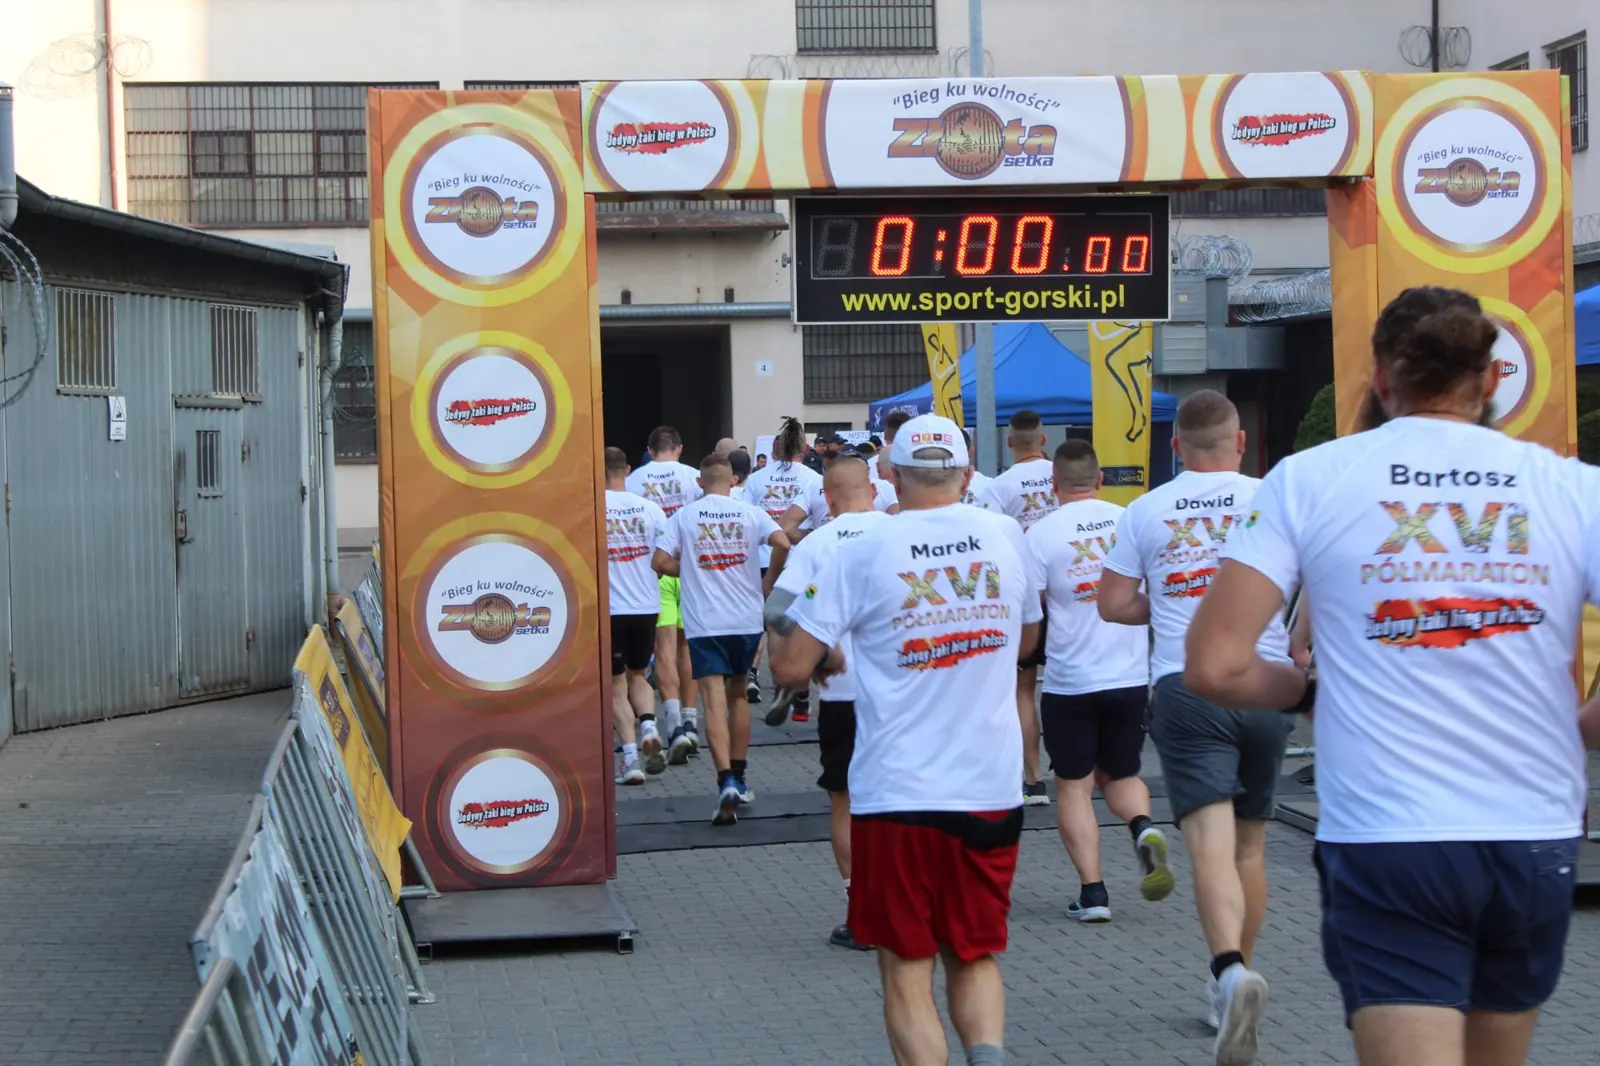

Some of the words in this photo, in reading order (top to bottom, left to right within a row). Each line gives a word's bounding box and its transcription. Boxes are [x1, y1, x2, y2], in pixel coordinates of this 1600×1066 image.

[946, 81, 966, 97] ku
[606, 130, 637, 147] Jedyny
[639, 130, 656, 144] taki
[657, 128, 676, 143] bieg
[677, 129, 686, 140] w
[686, 126, 716, 139] Polsce
[1231, 123, 1261, 140] Jedyny
[1262, 124, 1279, 136] taki
[1280, 121, 1297, 134] bieg
[1298, 121, 1307, 131] w
[1307, 117, 1336, 129] Polsce
[1451, 144, 1464, 155] ku
[1003, 155, 1054, 167] setka
[463, 172, 477, 183] ku
[1487, 190, 1519, 199] setka
[503, 220, 537, 229] setka
[841, 283, 1126, 316] www.sport-gorski.pl
[1501, 363, 1518, 375] lsce
[444, 407, 471, 421] Jedyny
[472, 406, 486, 418] taki
[487, 404, 502, 416] bieg
[503, 404, 511, 413] w
[511, 401, 536, 412] Polsce
[1390, 464, 1518, 488] Bartosz
[1176, 494, 1235, 510] Dawid
[605, 505, 645, 516] rzysztof
[699, 510, 742, 520] Mateusz
[697, 521, 745, 541] XVI
[1076, 519, 1116, 534] Adam
[1373, 500, 1530, 556] XVI
[910, 535, 982, 560] Marek
[1360, 556, 1550, 586] PÓŁMARATON
[477, 580, 491, 591] ku
[896, 560, 1000, 610] XVI
[891, 603, 1011, 631] PÓŁMARATON
[516, 626, 550, 635] setka
[457, 810, 484, 824] Jedyny
[484, 808, 499, 820] taki
[499, 805, 515, 818] bieg
[516, 805, 524, 815] w
[524, 802, 549, 813] Polsce
